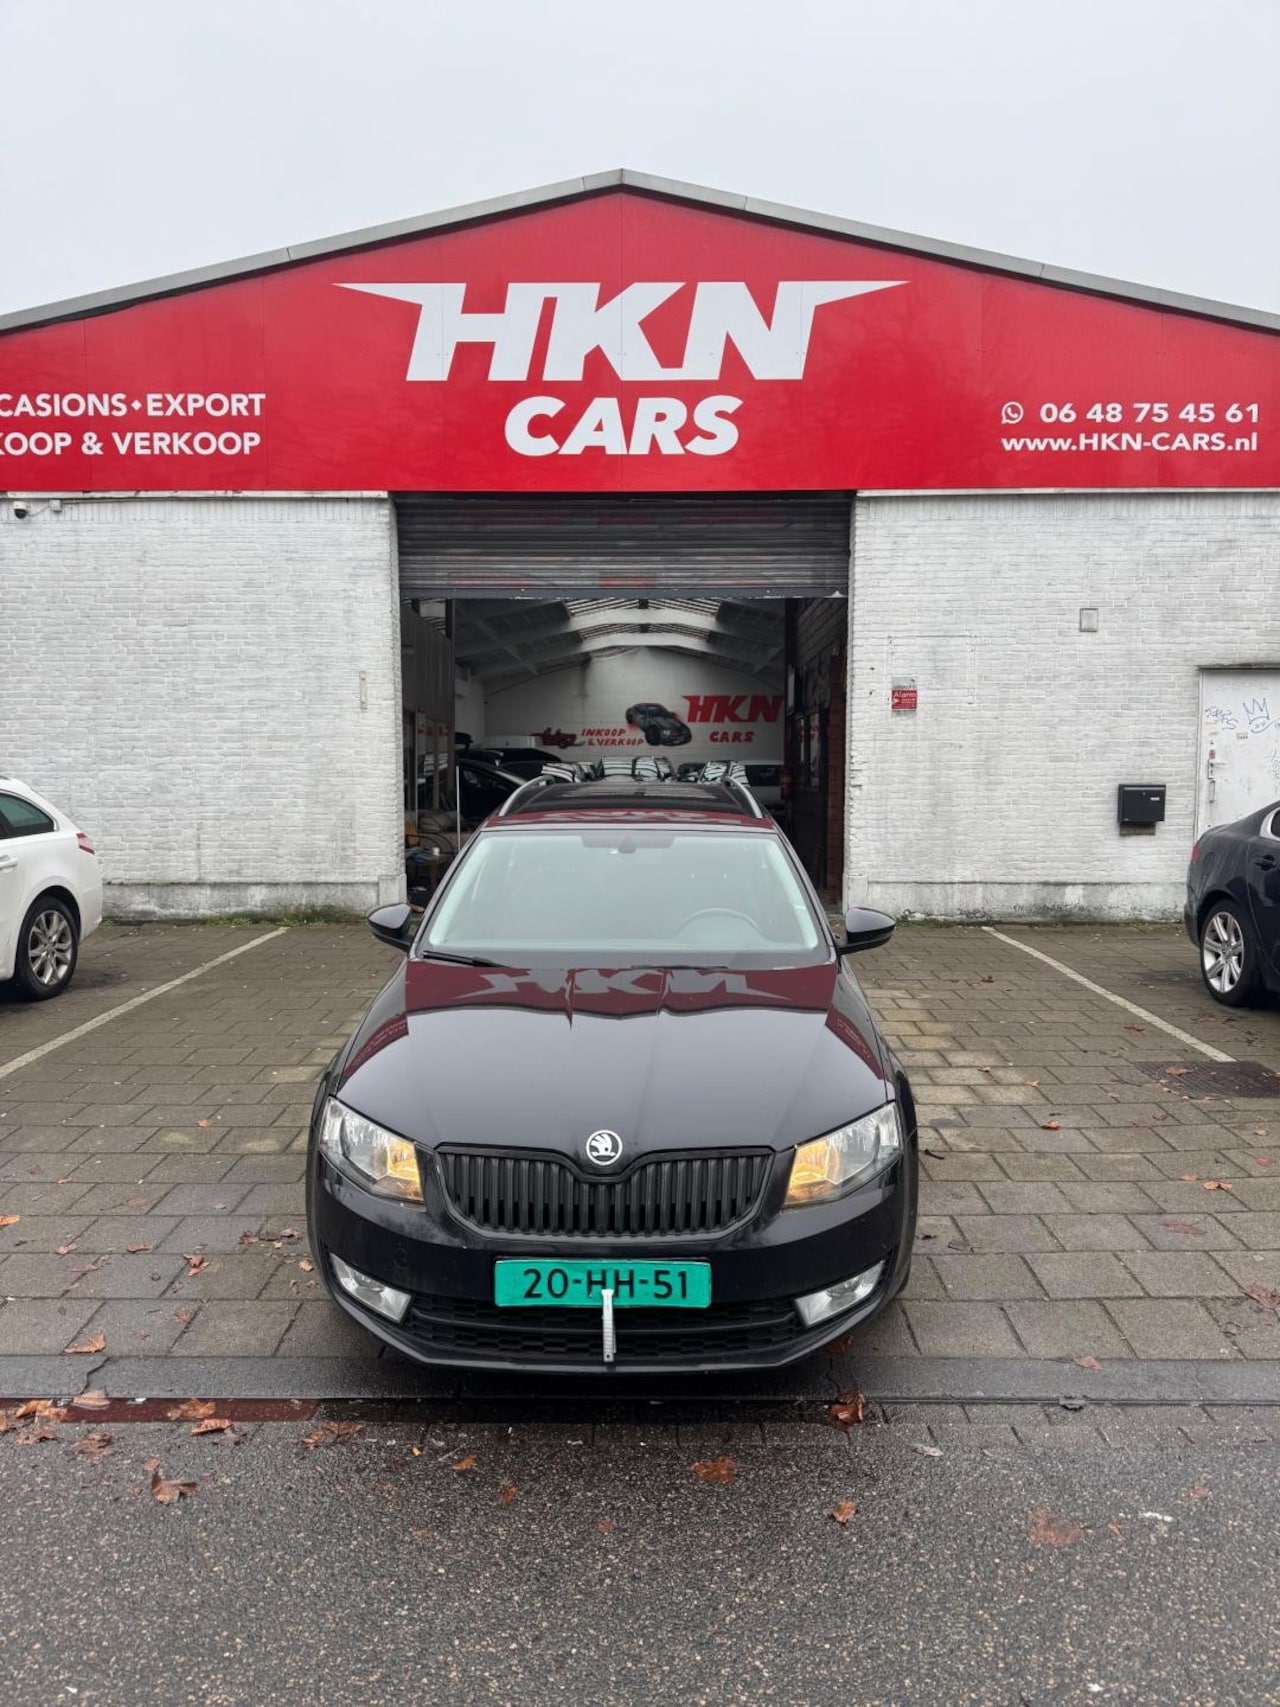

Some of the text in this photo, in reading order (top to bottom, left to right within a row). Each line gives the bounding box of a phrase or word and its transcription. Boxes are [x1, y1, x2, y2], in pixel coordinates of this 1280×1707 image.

[331, 281, 911, 381] HKN
[146, 393, 266, 417] EXPORT
[1040, 403, 1259, 423] 06 48 75 45 61
[504, 395, 744, 456] CARS
[0, 431, 261, 456] OOP & VERKOOP
[1001, 432, 1258, 451] www.HKN-CARS.nl
[681, 695, 785, 723] HKN
[581, 728, 626, 737] INKOOP
[709, 731, 755, 743] CARS
[523, 1268, 687, 1299] 20-HH-51
